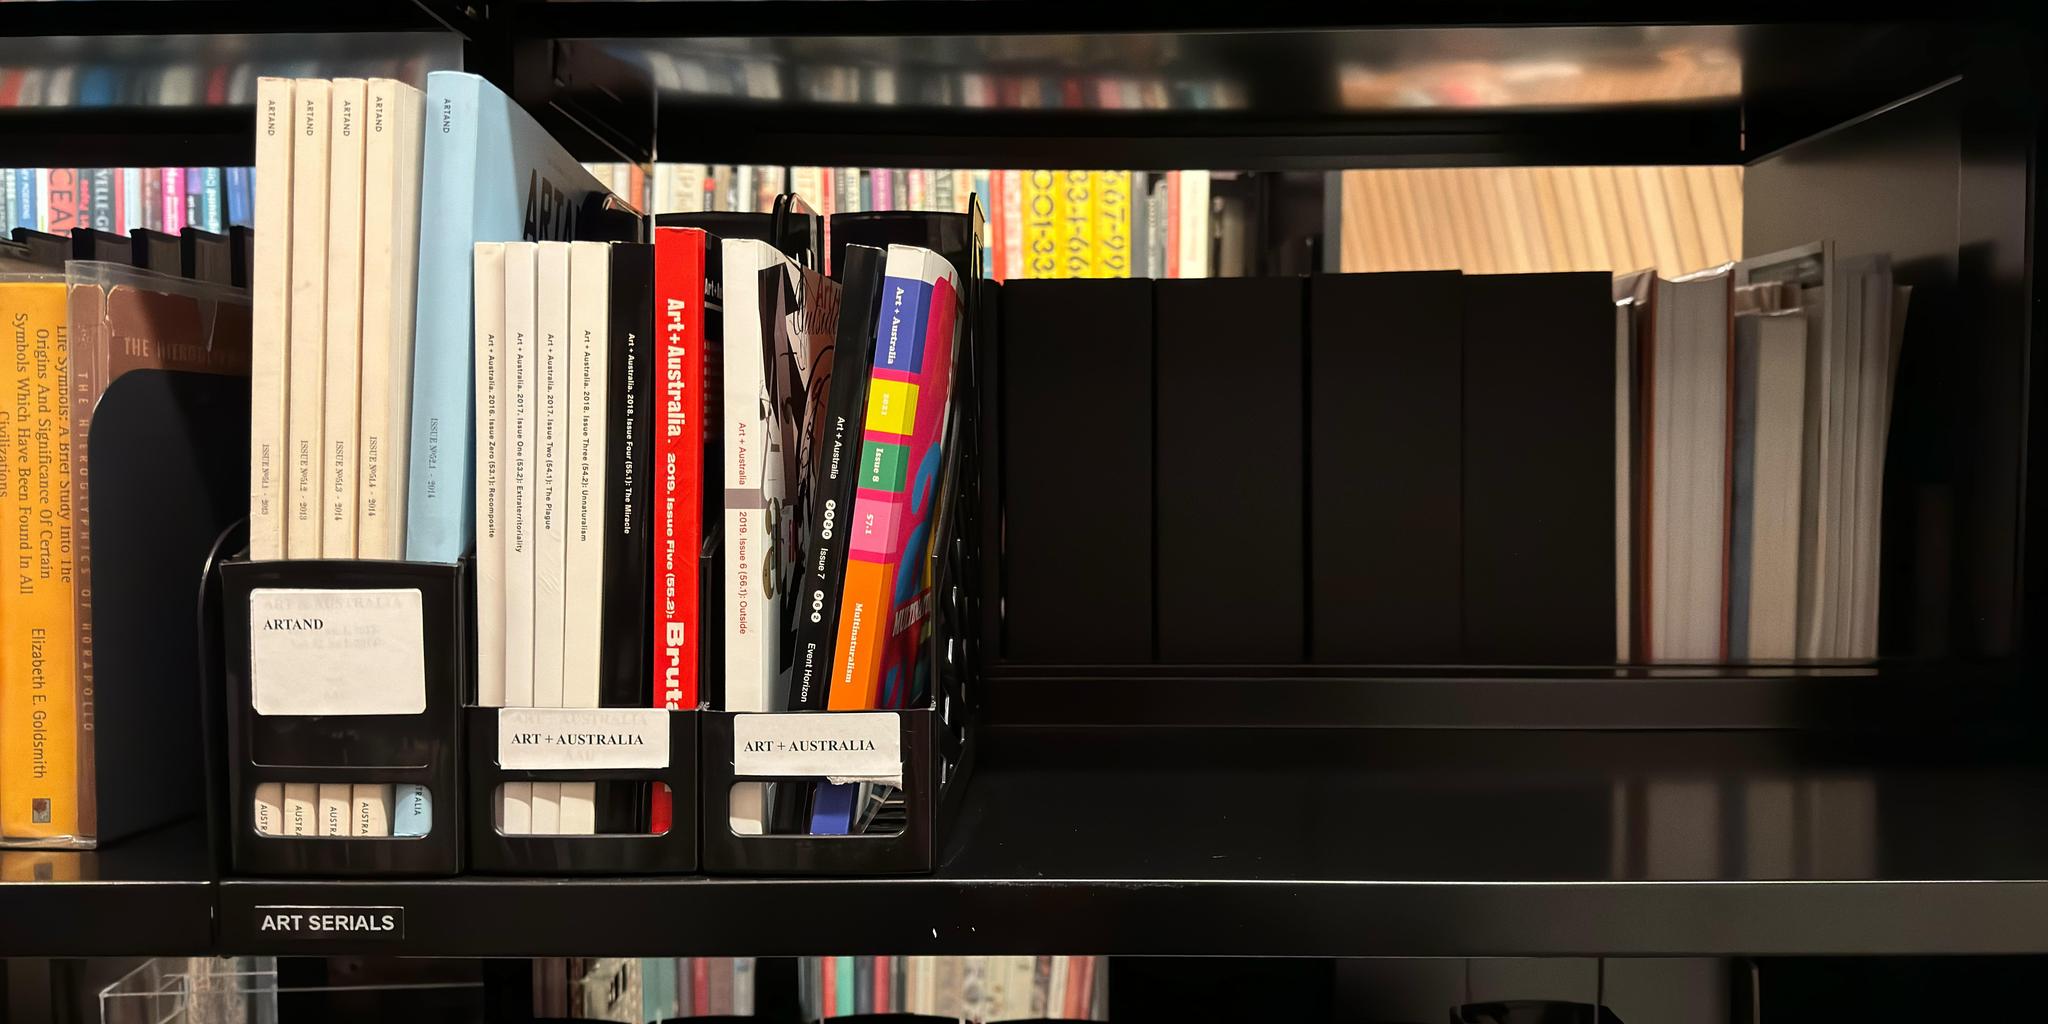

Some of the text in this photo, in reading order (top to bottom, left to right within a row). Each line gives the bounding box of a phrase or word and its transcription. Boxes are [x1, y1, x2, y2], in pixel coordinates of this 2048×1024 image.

[268, 99, 276, 137] ARTAND
[306, 99, 315, 137] ARTAND
[343, 100, 351, 137] ARTAND
[375, 96, 383, 133] ARTAND
[443, 98, 452, 134] ARTAND
[895, 286, 905, 306] Art
[56, 326, 67, 352] Life
[124, 337, 150, 357] THE
[628, 333, 636, 347] Art
[887, 316, 901, 365] Australia
[583, 351, 591, 390] Australia.
[627, 354, 635, 393] Australia.
[55, 357, 68, 420] Symbols:
[78, 373, 89, 404] THE
[516, 394, 524, 416] 2017.
[59, 426, 69, 437] A
[430, 418, 439, 444] ISSUE
[516, 418, 524, 439] Issue
[546, 419, 554, 441] Issue
[582, 416, 590, 437] Issue
[626, 419, 634, 440] Issue
[738, 422, 747, 437] Art
[837, 416, 846, 431] Art
[0, 411, 11, 498] Civilizations
[12, 313, 33, 595] Symbols Which Have Been Found In All
[34, 329, 54, 579] Origins And Significance Of Certain
[59, 442, 70, 474] Brief
[262, 444, 270, 467] ISSUE
[300, 440, 309, 466] ISSUE
[335, 441, 344, 467] ISSUE
[369, 436, 378, 463] ISSUE
[516, 440, 524, 457] One
[546, 442, 554, 458] Two
[626, 442, 634, 460] Four
[829, 440, 843, 480] Australia
[488, 459, 496, 486] (53.1):
[515, 458, 524, 484] (53.2):
[545, 460, 553, 485] (54.1):
[581, 463, 589, 488] (54.2):
[624, 460, 633, 487] (55.1):
[667, 452, 677, 495] 2019.
[738, 446, 747, 486] Australia
[872, 447, 884, 483] Issue 8
[57, 480, 71, 520] Study
[368, 498, 377, 517] 2014
[624, 487, 632, 503] The
[334, 502, 343, 521] 2014
[487, 488, 495, 539] Recomposite
[515, 486, 523, 553] Extraterritoriality
[543, 503, 552, 530] Plague
[580, 489, 589, 542] Unnaturalism
[623, 504, 632, 535] Miracle
[666, 498, 676, 537] Issue
[739, 511, 748, 536] 2019.
[821, 499, 836, 540] 2020
[865, 512, 874, 535] 57.1
[60, 526, 72, 553] Into
[739, 538, 748, 562] Issue
[666, 539, 676, 571] Five
[818, 547, 829, 572] Issue
[665, 572, 676, 619] (55.2):
[738, 571, 748, 599] (56.1):
[263, 618, 324, 631] ARTAND
[738, 600, 748, 635] Outside
[844, 602, 864, 684] Multinaturalism
[82, 623, 94, 732] HORAPOLLO
[800, 642, 816, 703] Event Horizon
[31, 628, 46, 779] Elizabeth E. Goldsmith
[511, 733, 644, 746] ART + AUSTRALIA
[744, 739, 875, 752] ART + AUSTRALIA
[261, 914, 395, 932] ART SERIALS
